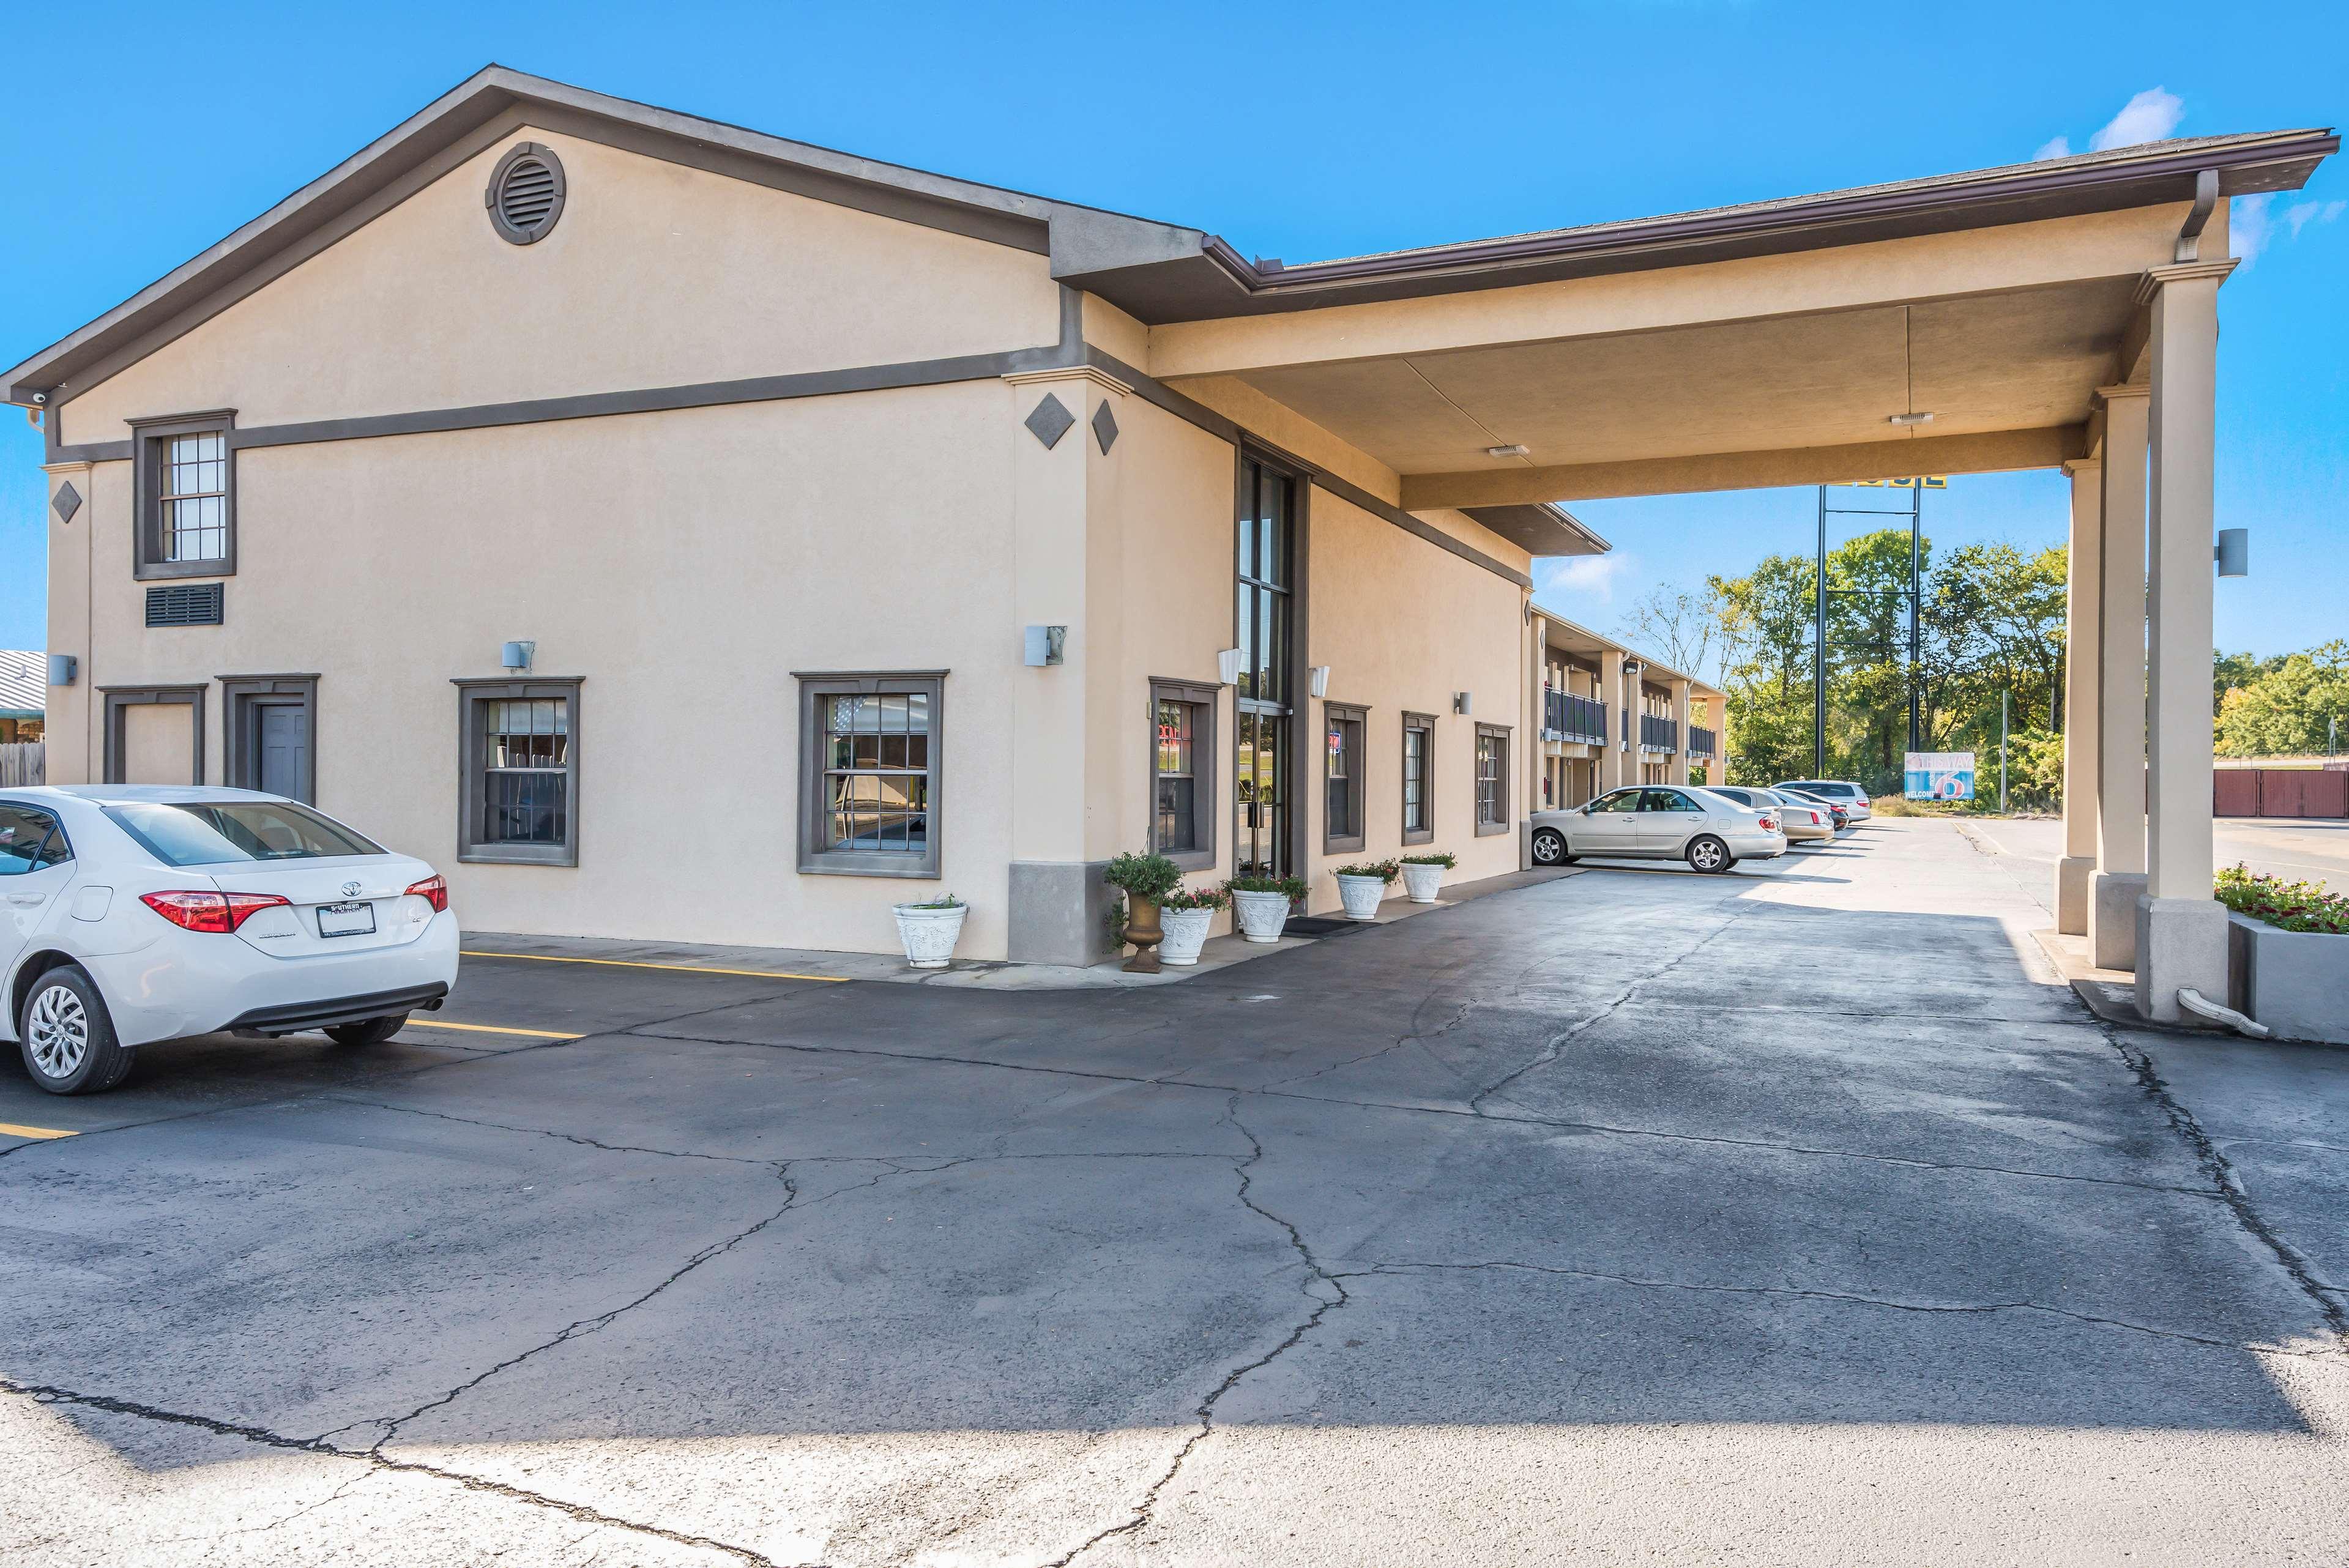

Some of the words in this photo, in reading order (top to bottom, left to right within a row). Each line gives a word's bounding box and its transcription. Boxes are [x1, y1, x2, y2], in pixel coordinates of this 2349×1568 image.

[1920, 756, 1944, 768] THIS
[1947, 756, 1970, 768] WAY
[1935, 771, 1965, 799] 6
